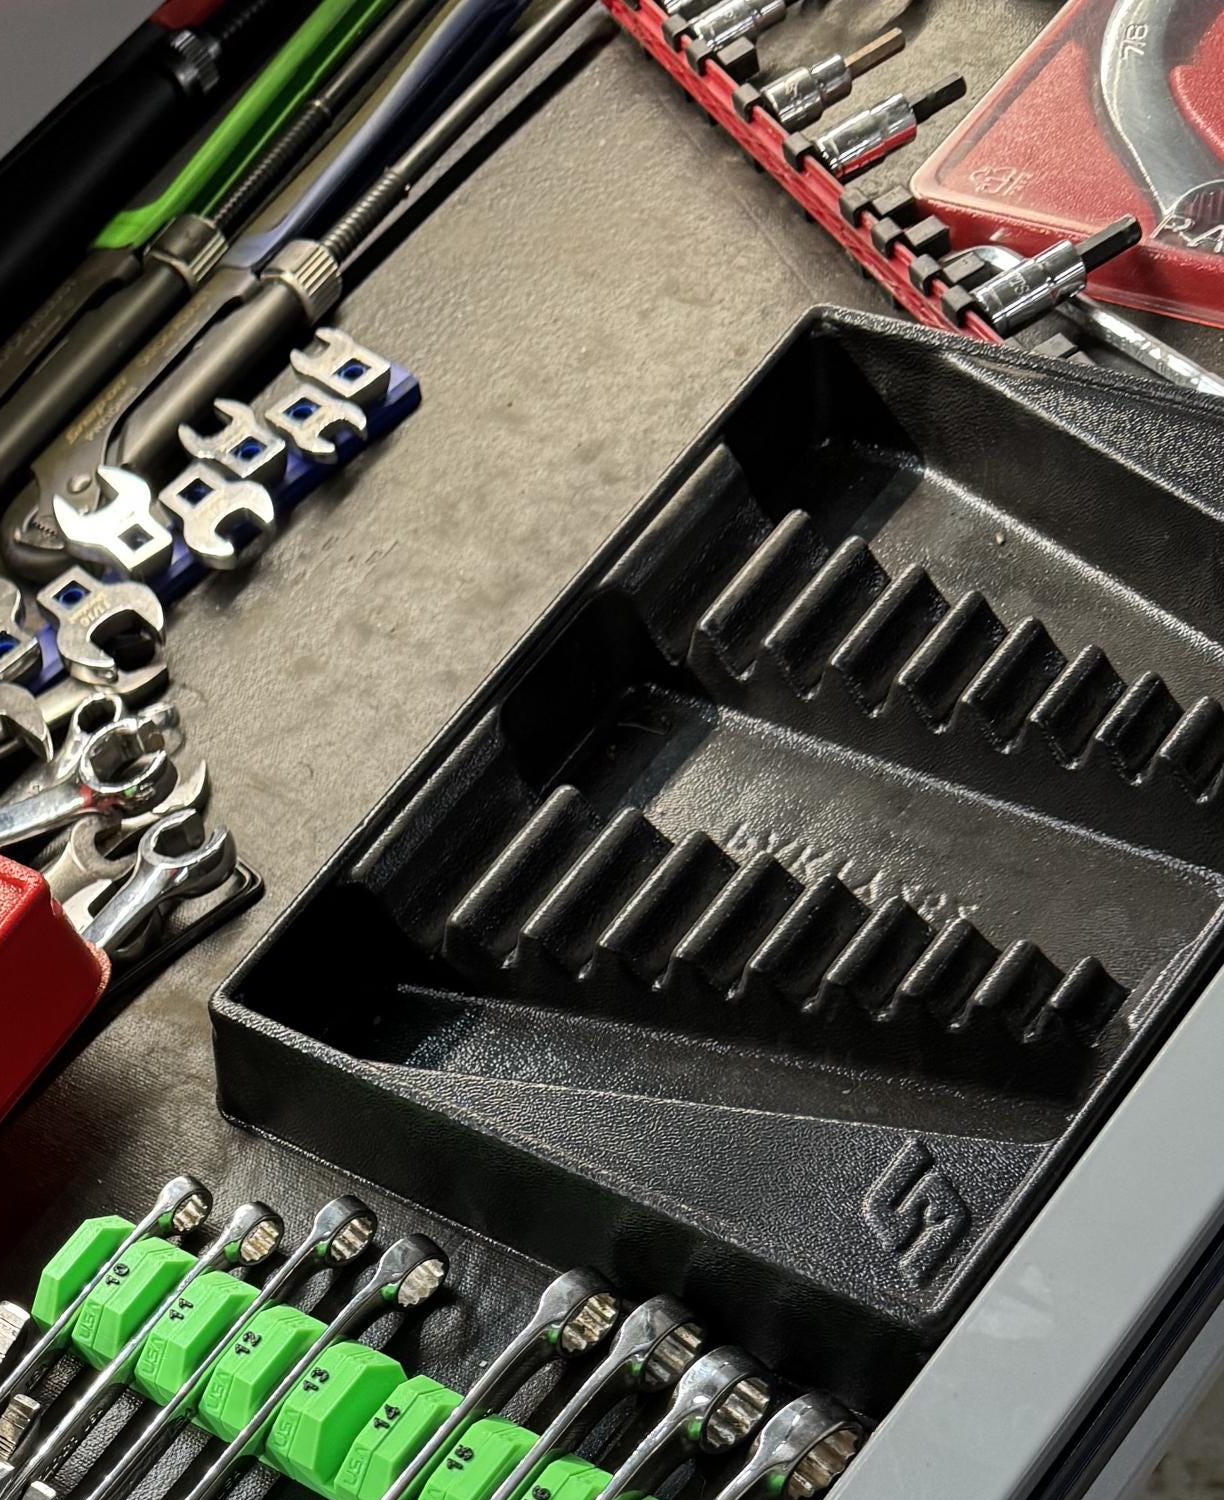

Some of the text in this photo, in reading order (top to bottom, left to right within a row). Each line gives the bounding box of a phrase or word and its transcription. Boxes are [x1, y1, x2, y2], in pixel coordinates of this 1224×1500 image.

[105, 1262, 130, 1287] 10
[168, 1298, 194, 1322] 11
[234, 1330, 263, 1356] 12
[302, 1366, 330, 1393] 13
[372, 1403, 401, 1431] 14
[446, 1444, 475, 1472] 15
